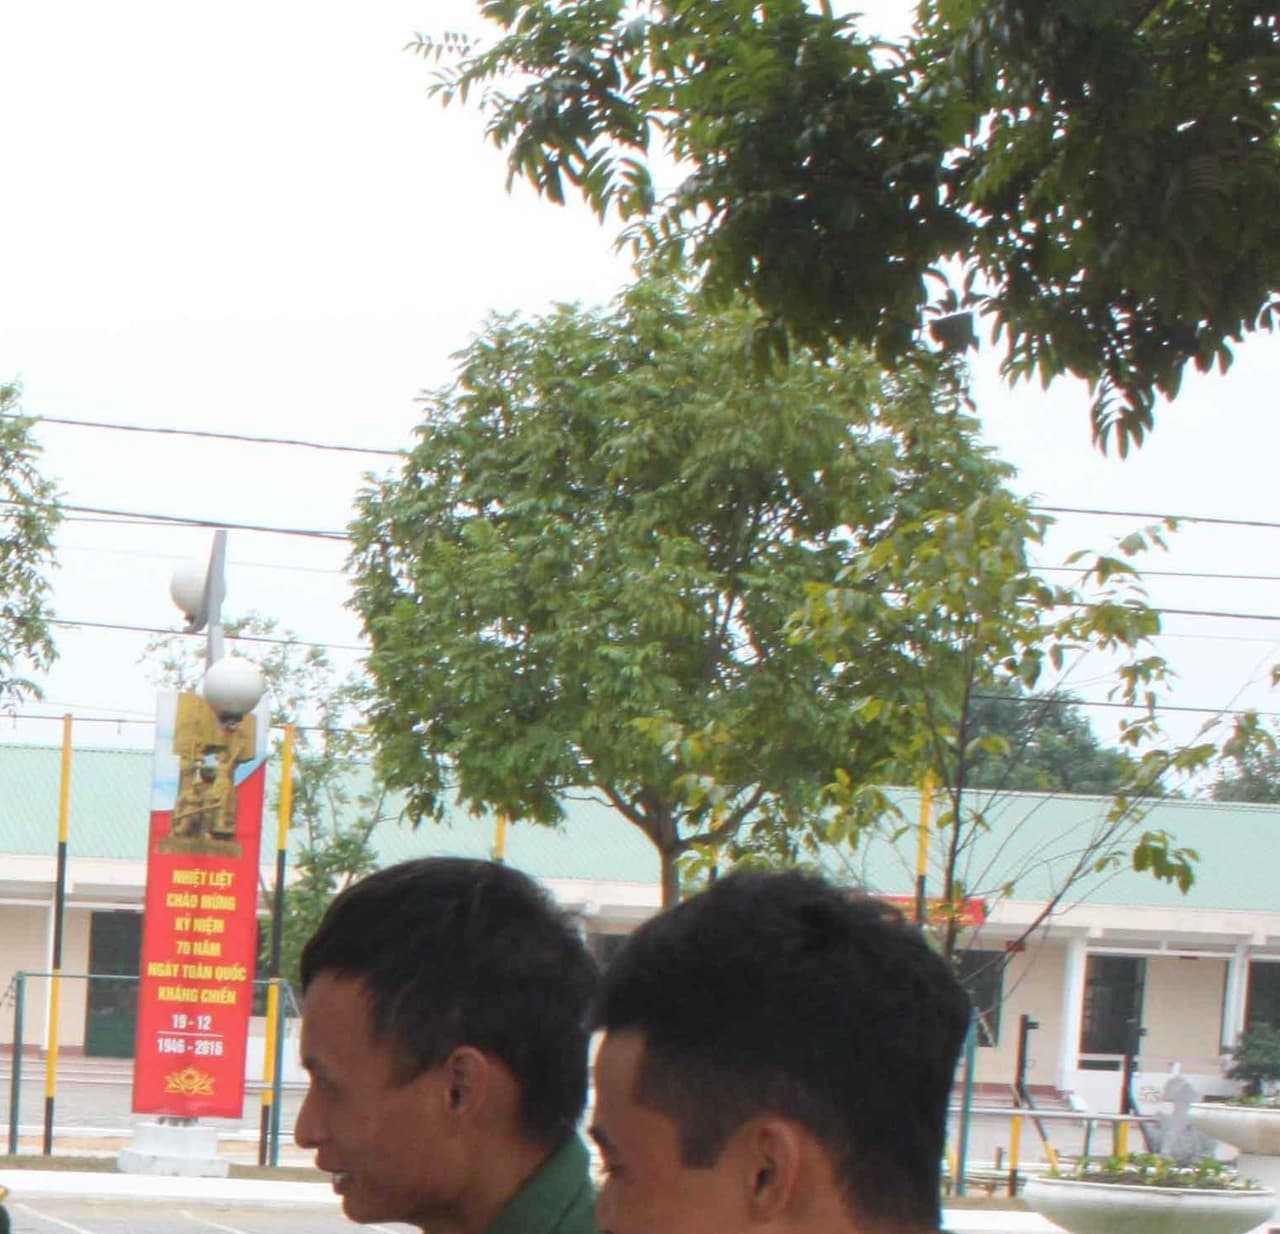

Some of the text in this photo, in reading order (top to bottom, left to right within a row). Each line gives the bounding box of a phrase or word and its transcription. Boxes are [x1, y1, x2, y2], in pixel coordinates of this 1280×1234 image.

[176, 941, 190, 955] 70
[171, 1013, 187, 1029] 19
[197, 1015, 212, 1031] 12
